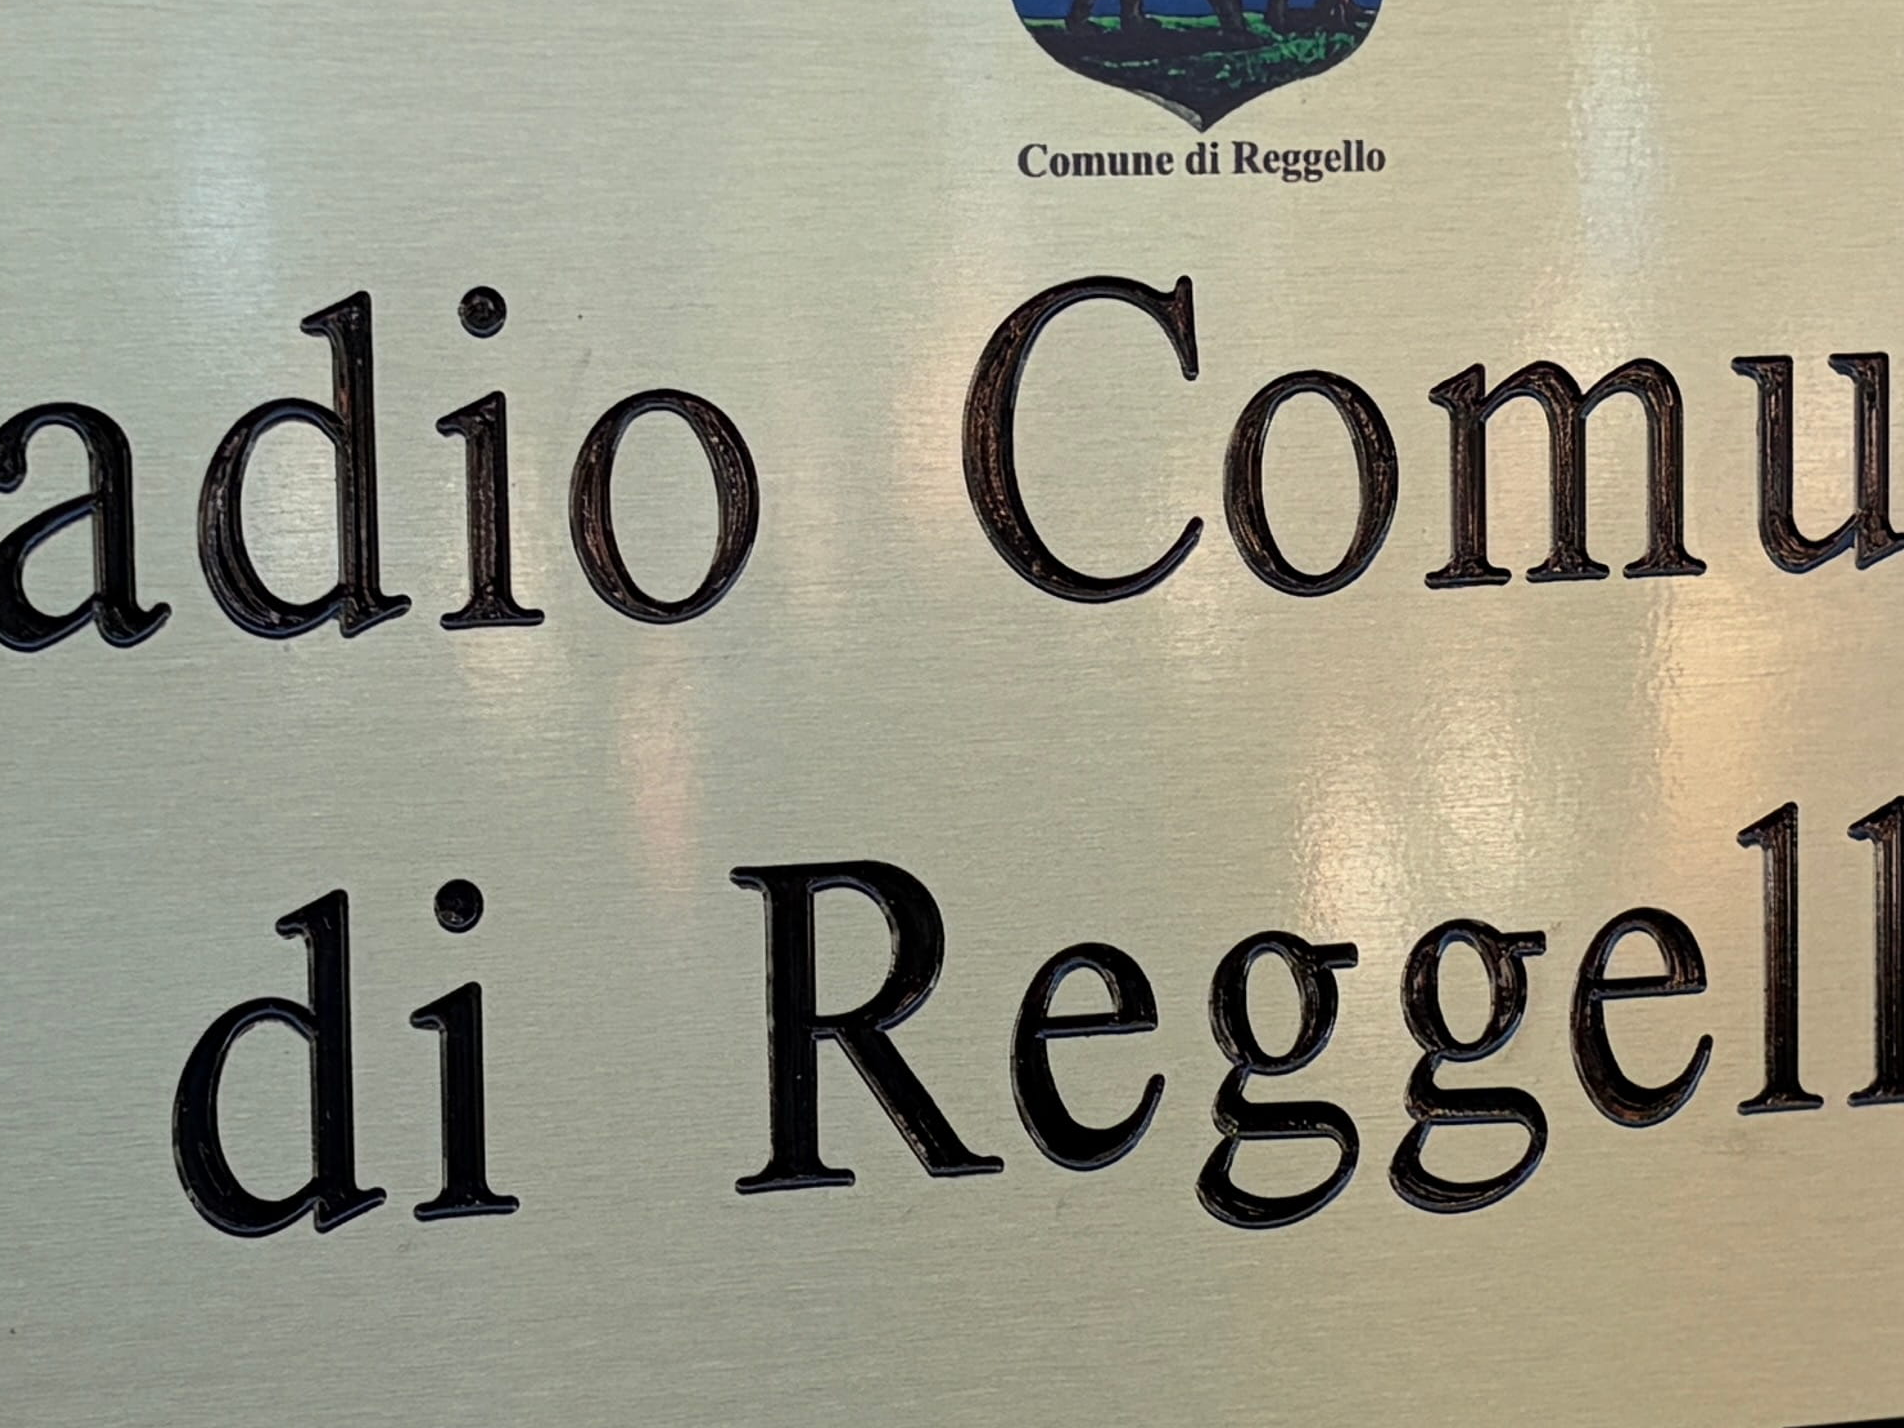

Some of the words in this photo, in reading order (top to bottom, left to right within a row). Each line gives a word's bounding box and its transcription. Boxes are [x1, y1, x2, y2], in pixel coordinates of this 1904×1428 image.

[1017, 143, 1174, 178] Comune
[1185, 141, 1220, 176] di
[1232, 139, 1386, 183] Reggello
[170, 877, 521, 1240] di
